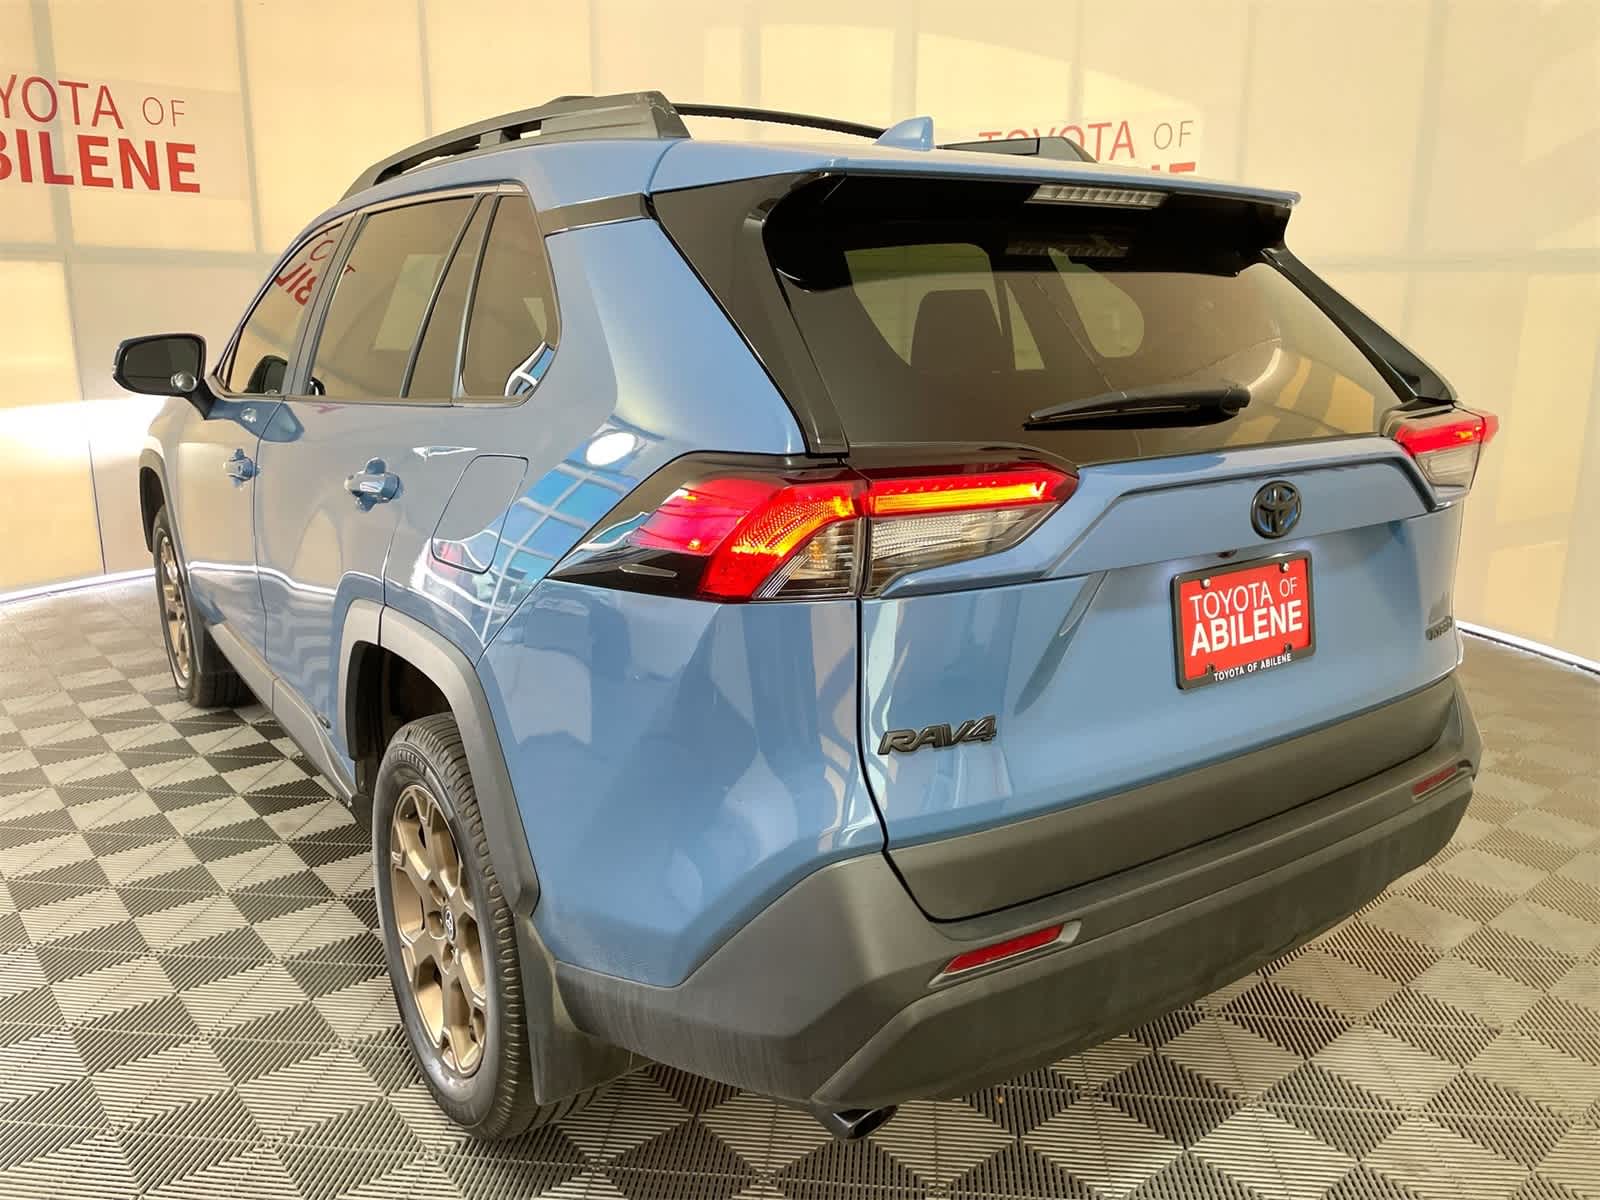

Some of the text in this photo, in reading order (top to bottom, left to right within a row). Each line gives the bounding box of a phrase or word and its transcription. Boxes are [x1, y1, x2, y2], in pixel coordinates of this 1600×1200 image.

[142, 96, 185, 127] OF
[1153, 120, 1194, 150] OF
[1189, 577, 1298, 621] TOYOTA OF
[1190, 600, 1303, 656] ABILENE
[1214, 653, 1292, 681] TOYOTA OF ABILENE
[878, 714, 997, 755] RAV4
